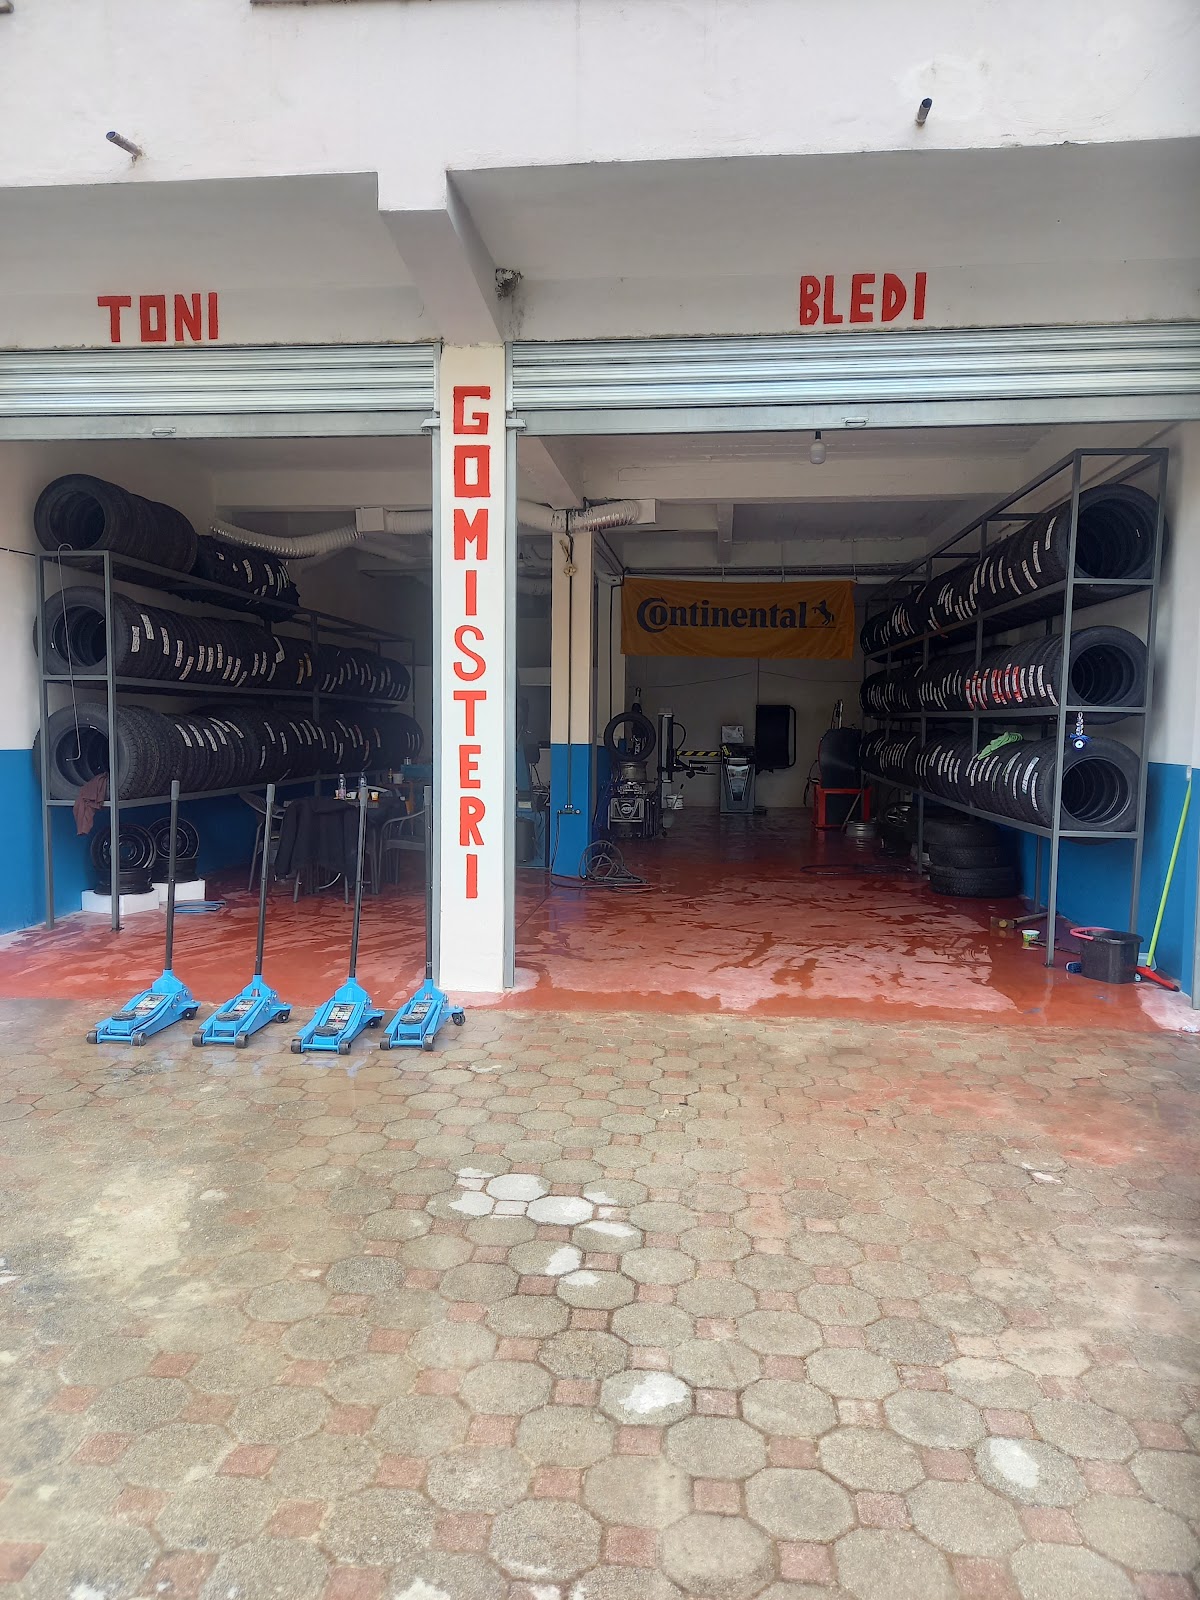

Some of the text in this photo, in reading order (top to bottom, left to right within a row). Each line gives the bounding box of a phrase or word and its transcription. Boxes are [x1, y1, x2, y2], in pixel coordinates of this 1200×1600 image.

[97, 292, 218, 343] TONI
[800, 272, 927, 325] BLEDI
[636, 596, 808, 634] Continental
[452, 385, 492, 900] GOMISTERI
